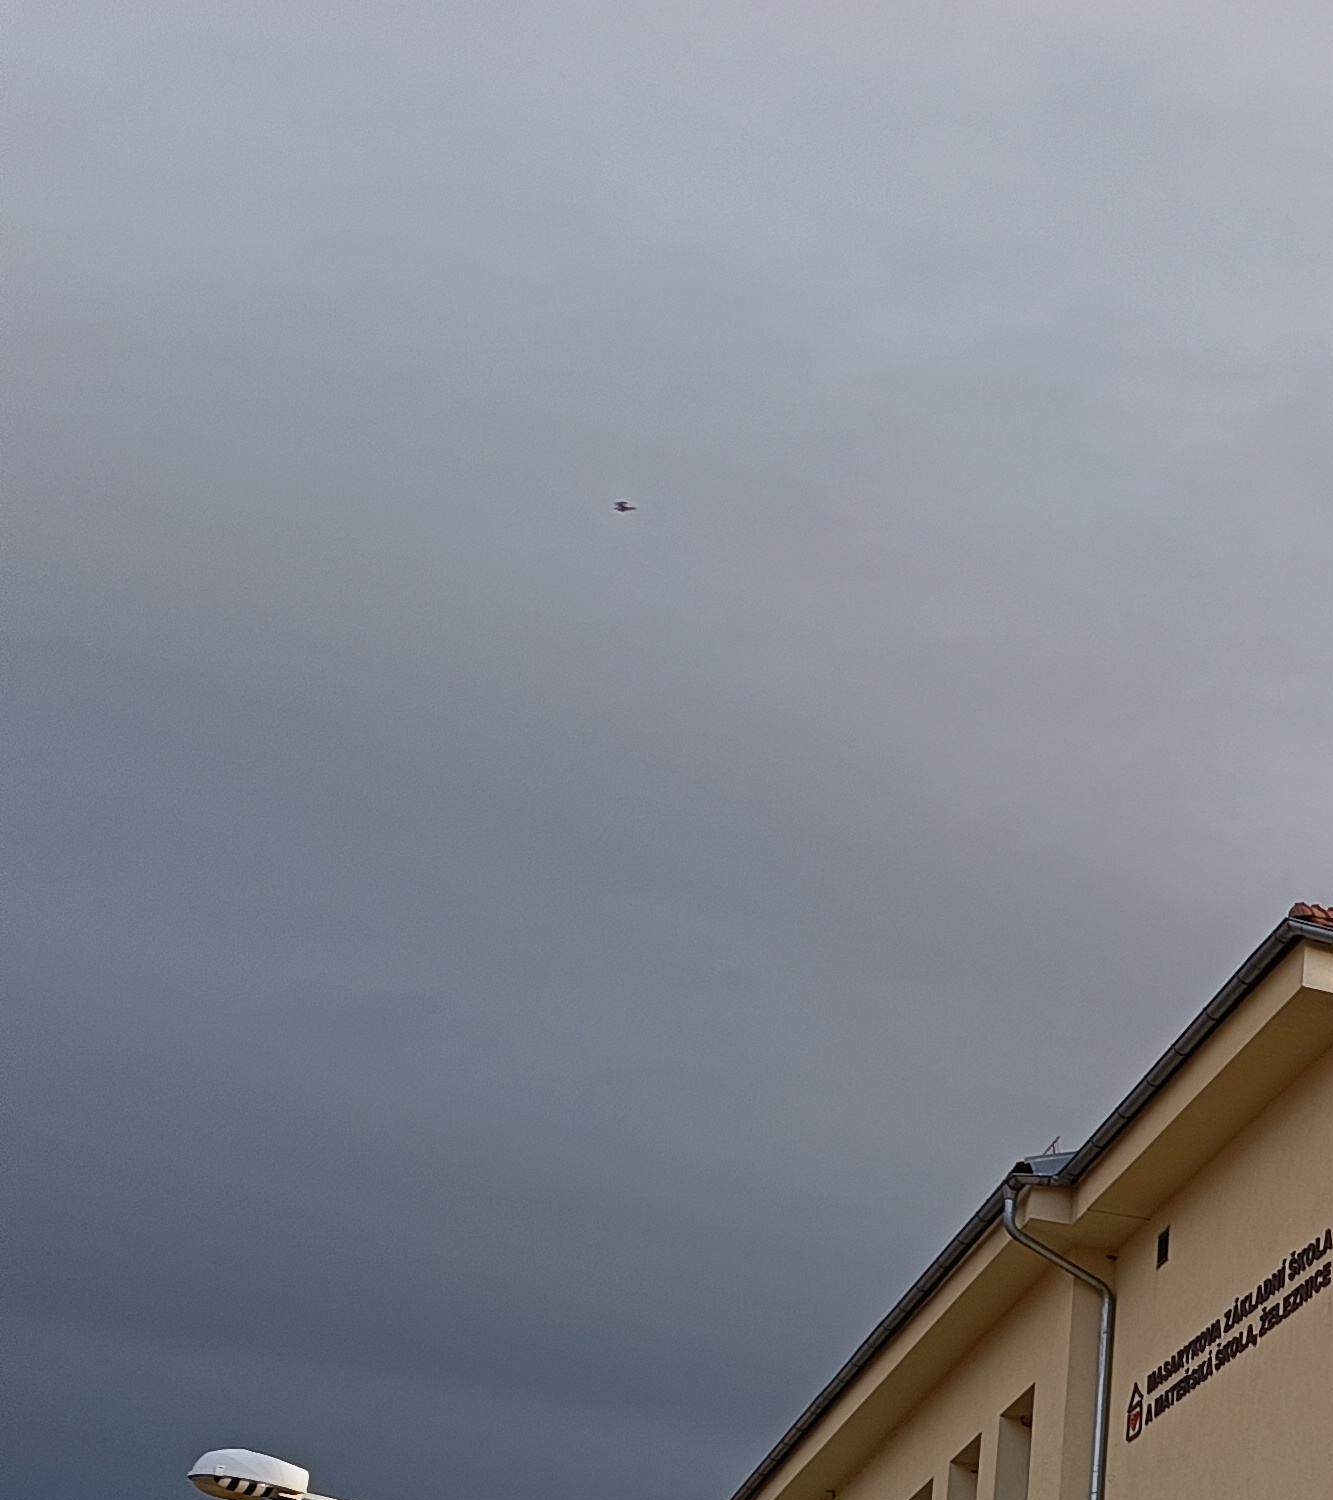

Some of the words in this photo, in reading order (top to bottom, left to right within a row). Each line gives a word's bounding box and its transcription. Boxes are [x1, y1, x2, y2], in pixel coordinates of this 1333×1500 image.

[1145, 1403, 1153, 1427] A
[1154, 1350, 1213, 1418] MATEŘSKÁ
[1215, 1324, 1258, 1372] ŠKOLA,
[1259, 1261, 1332, 1338] ŽELEZNICE
[1147, 1319, 1221, 1395] MASARYKOVA
[1223, 1259, 1287, 1333] ZÁKLADNÍ
[1288, 1228, 1332, 1281] ŠKOLA
